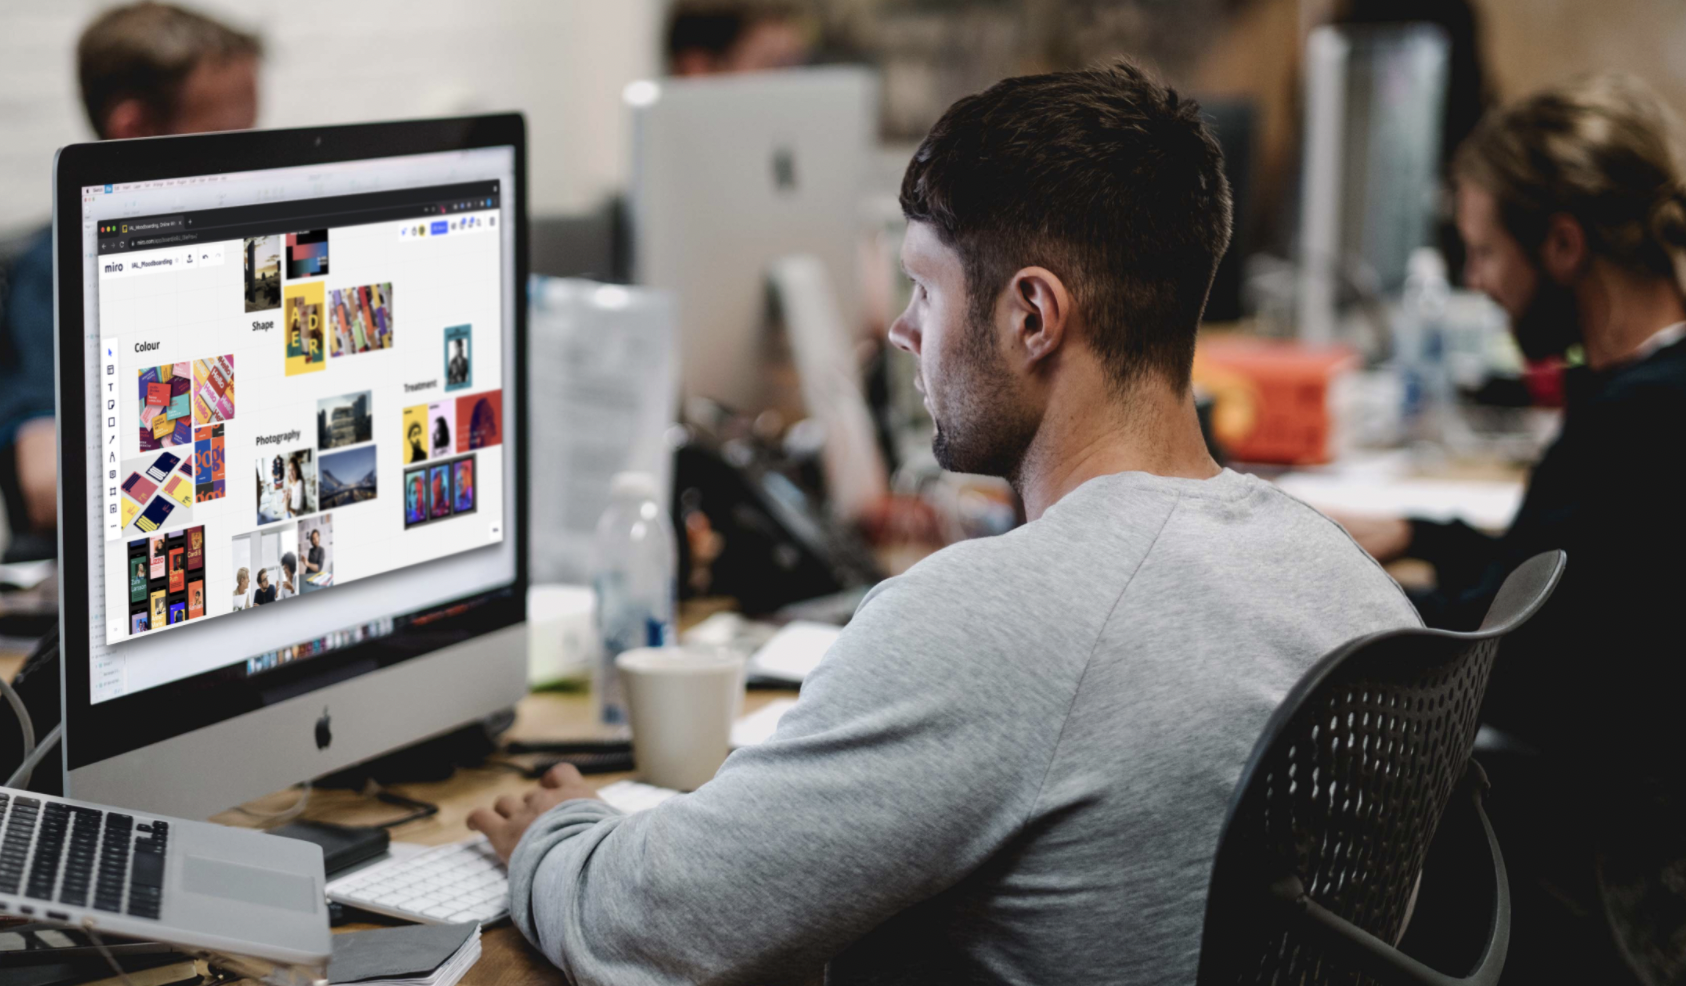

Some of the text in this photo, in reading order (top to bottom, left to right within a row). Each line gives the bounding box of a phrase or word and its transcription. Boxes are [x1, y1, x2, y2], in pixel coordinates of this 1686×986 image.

[105, 257, 173, 273] miro IAL_Moodboarding
[252, 320, 274, 332] Shape
[135, 340, 160, 353] Colour
[218, 356, 231, 376] Hello
[211, 368, 224, 388] Hello
[404, 379, 437, 393] Treatment
[204, 383, 217, 403] Hello
[195, 398, 208, 419] Hello
[220, 394, 233, 414] Hello
[256, 429, 301, 446] Photography
